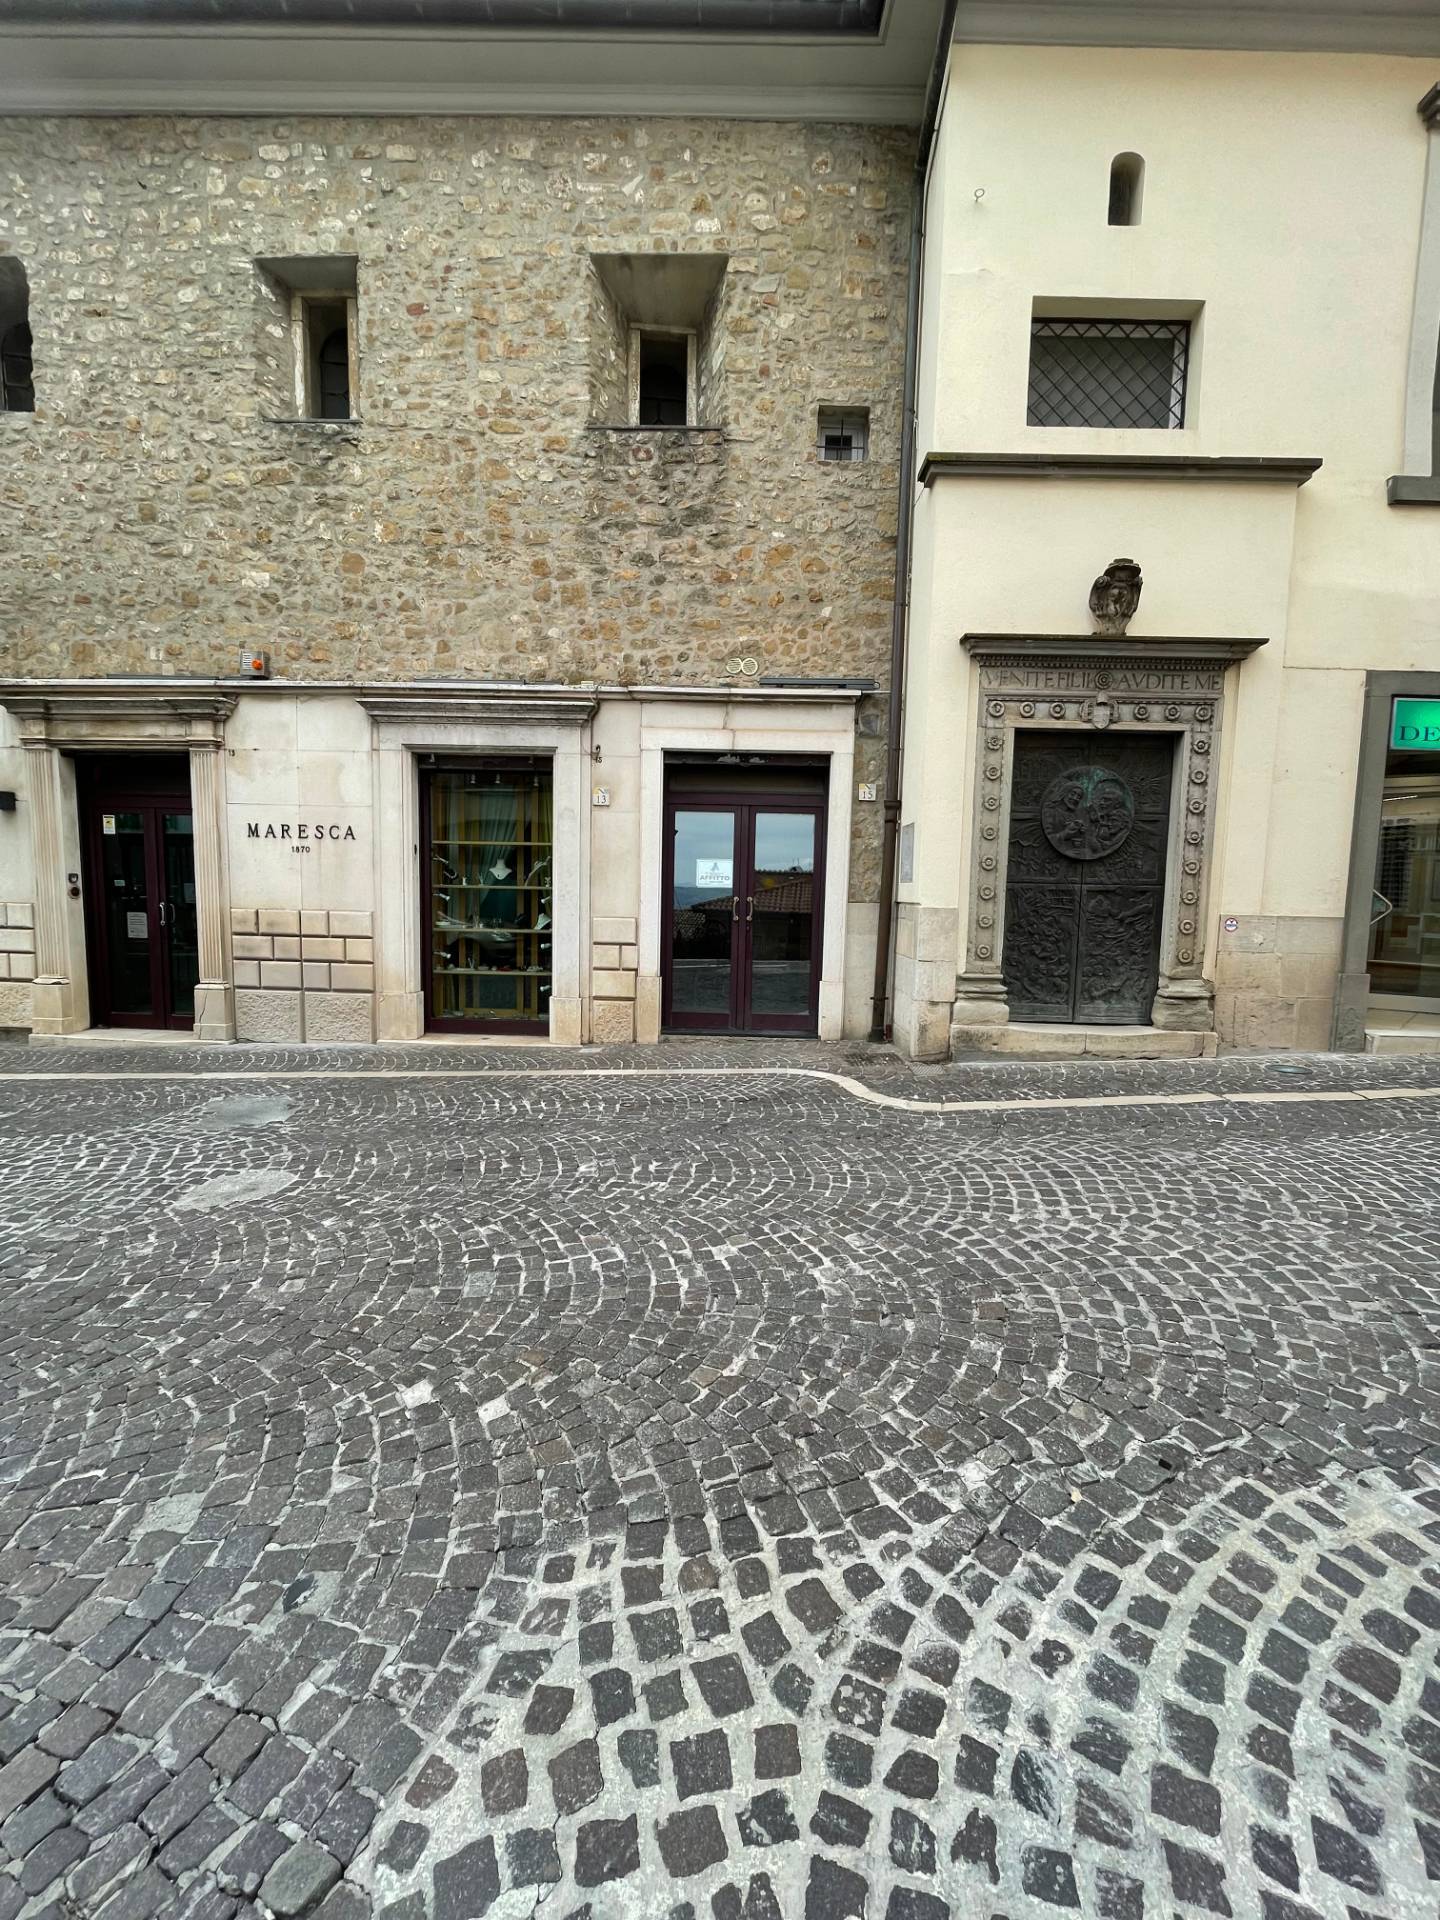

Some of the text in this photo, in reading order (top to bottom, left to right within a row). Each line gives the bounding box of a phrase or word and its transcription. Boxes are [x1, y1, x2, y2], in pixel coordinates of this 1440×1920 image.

[1118, 672, 1191, 691] AVDITE
[1194, 673, 1221, 691] ME
[596, 794, 606, 803] 13
[863, 791, 873, 799] 15
[247, 822, 356, 841] MARESCA
[291, 846, 311, 854] 1870
